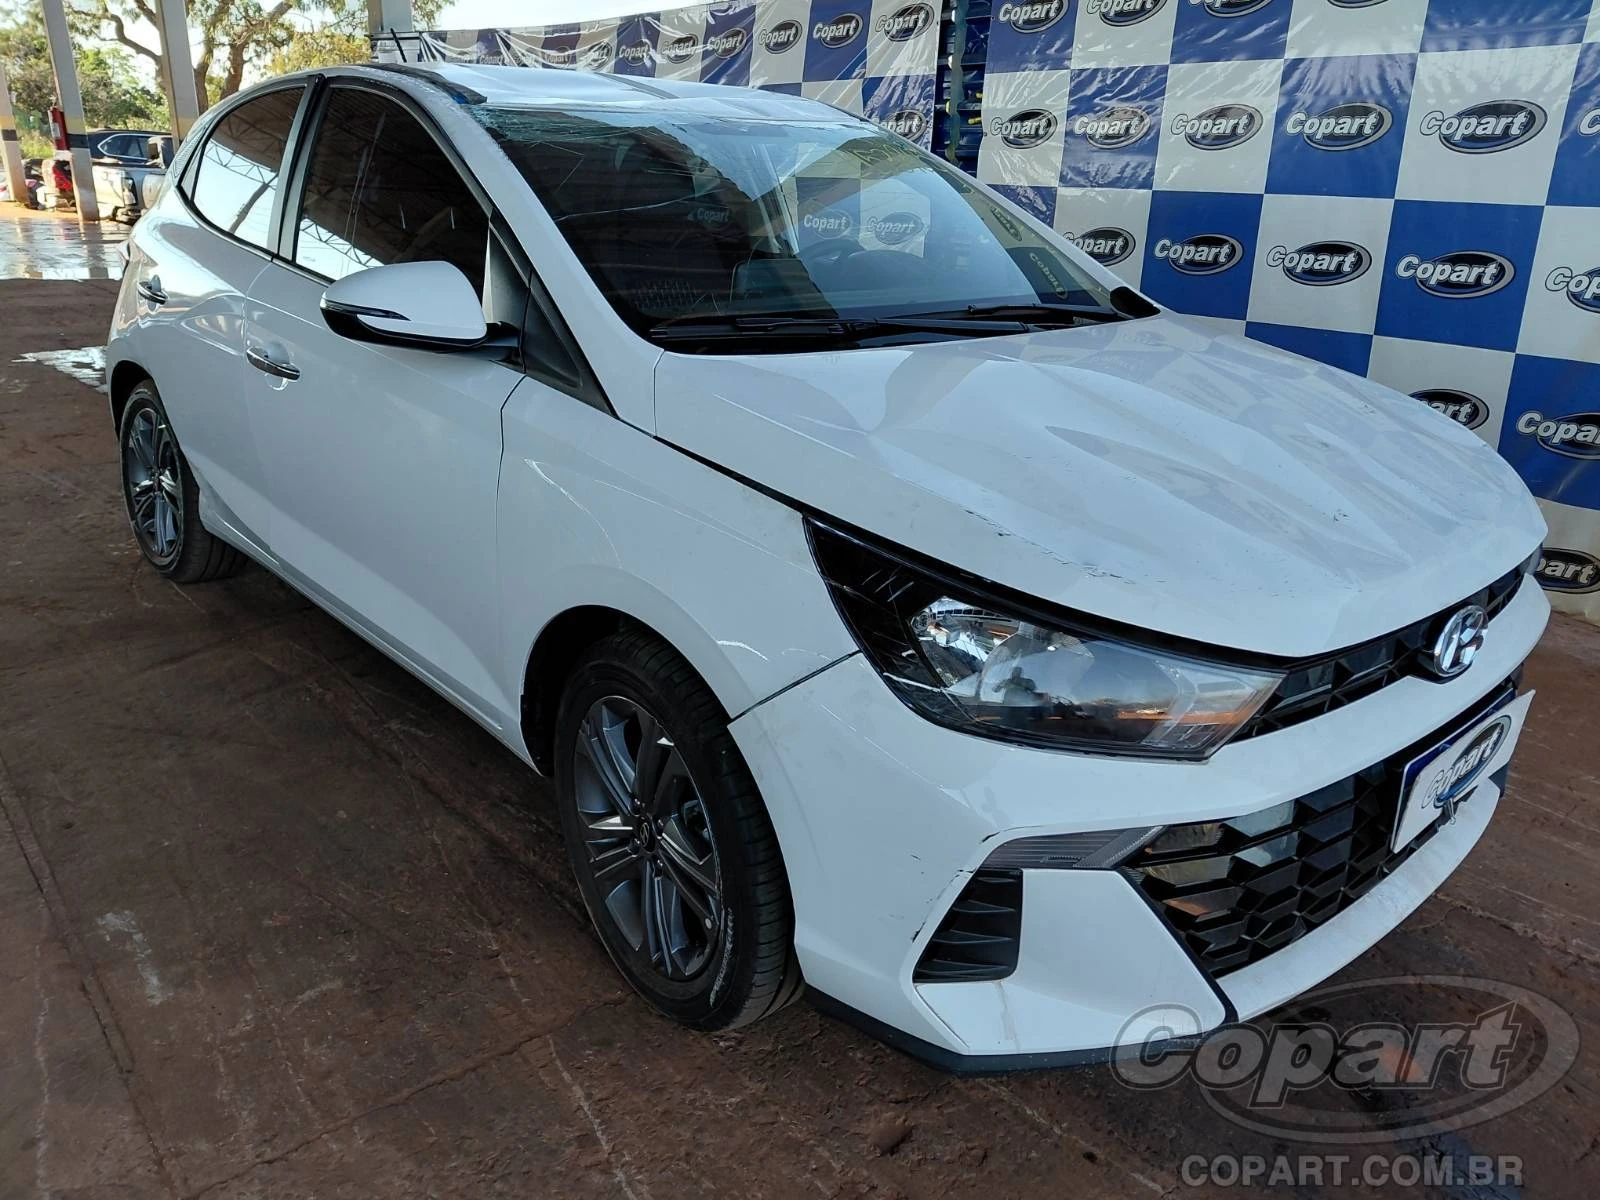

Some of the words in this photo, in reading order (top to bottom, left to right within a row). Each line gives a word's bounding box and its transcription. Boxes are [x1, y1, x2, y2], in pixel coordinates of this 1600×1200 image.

[875, 9, 926, 32] Copart
[999, 0, 1059, 25] Copart
[708, 33, 742, 52] Copart
[758, 26, 798, 50] Copart
[813, 18, 857, 44] Copart
[990, 116, 1048, 138] Copart
[1074, 115, 1141, 138] Copart
[1171, 113, 1251, 138] Copart
[1286, 110, 1379, 140] Copart
[1420, 107, 1531, 142] Copart
[1155, 239, 1232, 264] Copart
[1266, 245, 1358, 274] Copart
[1396, 254, 1500, 287] Copart
[1545, 266, 1600, 301] Cop
[1516, 410, 1600, 446] Copa
